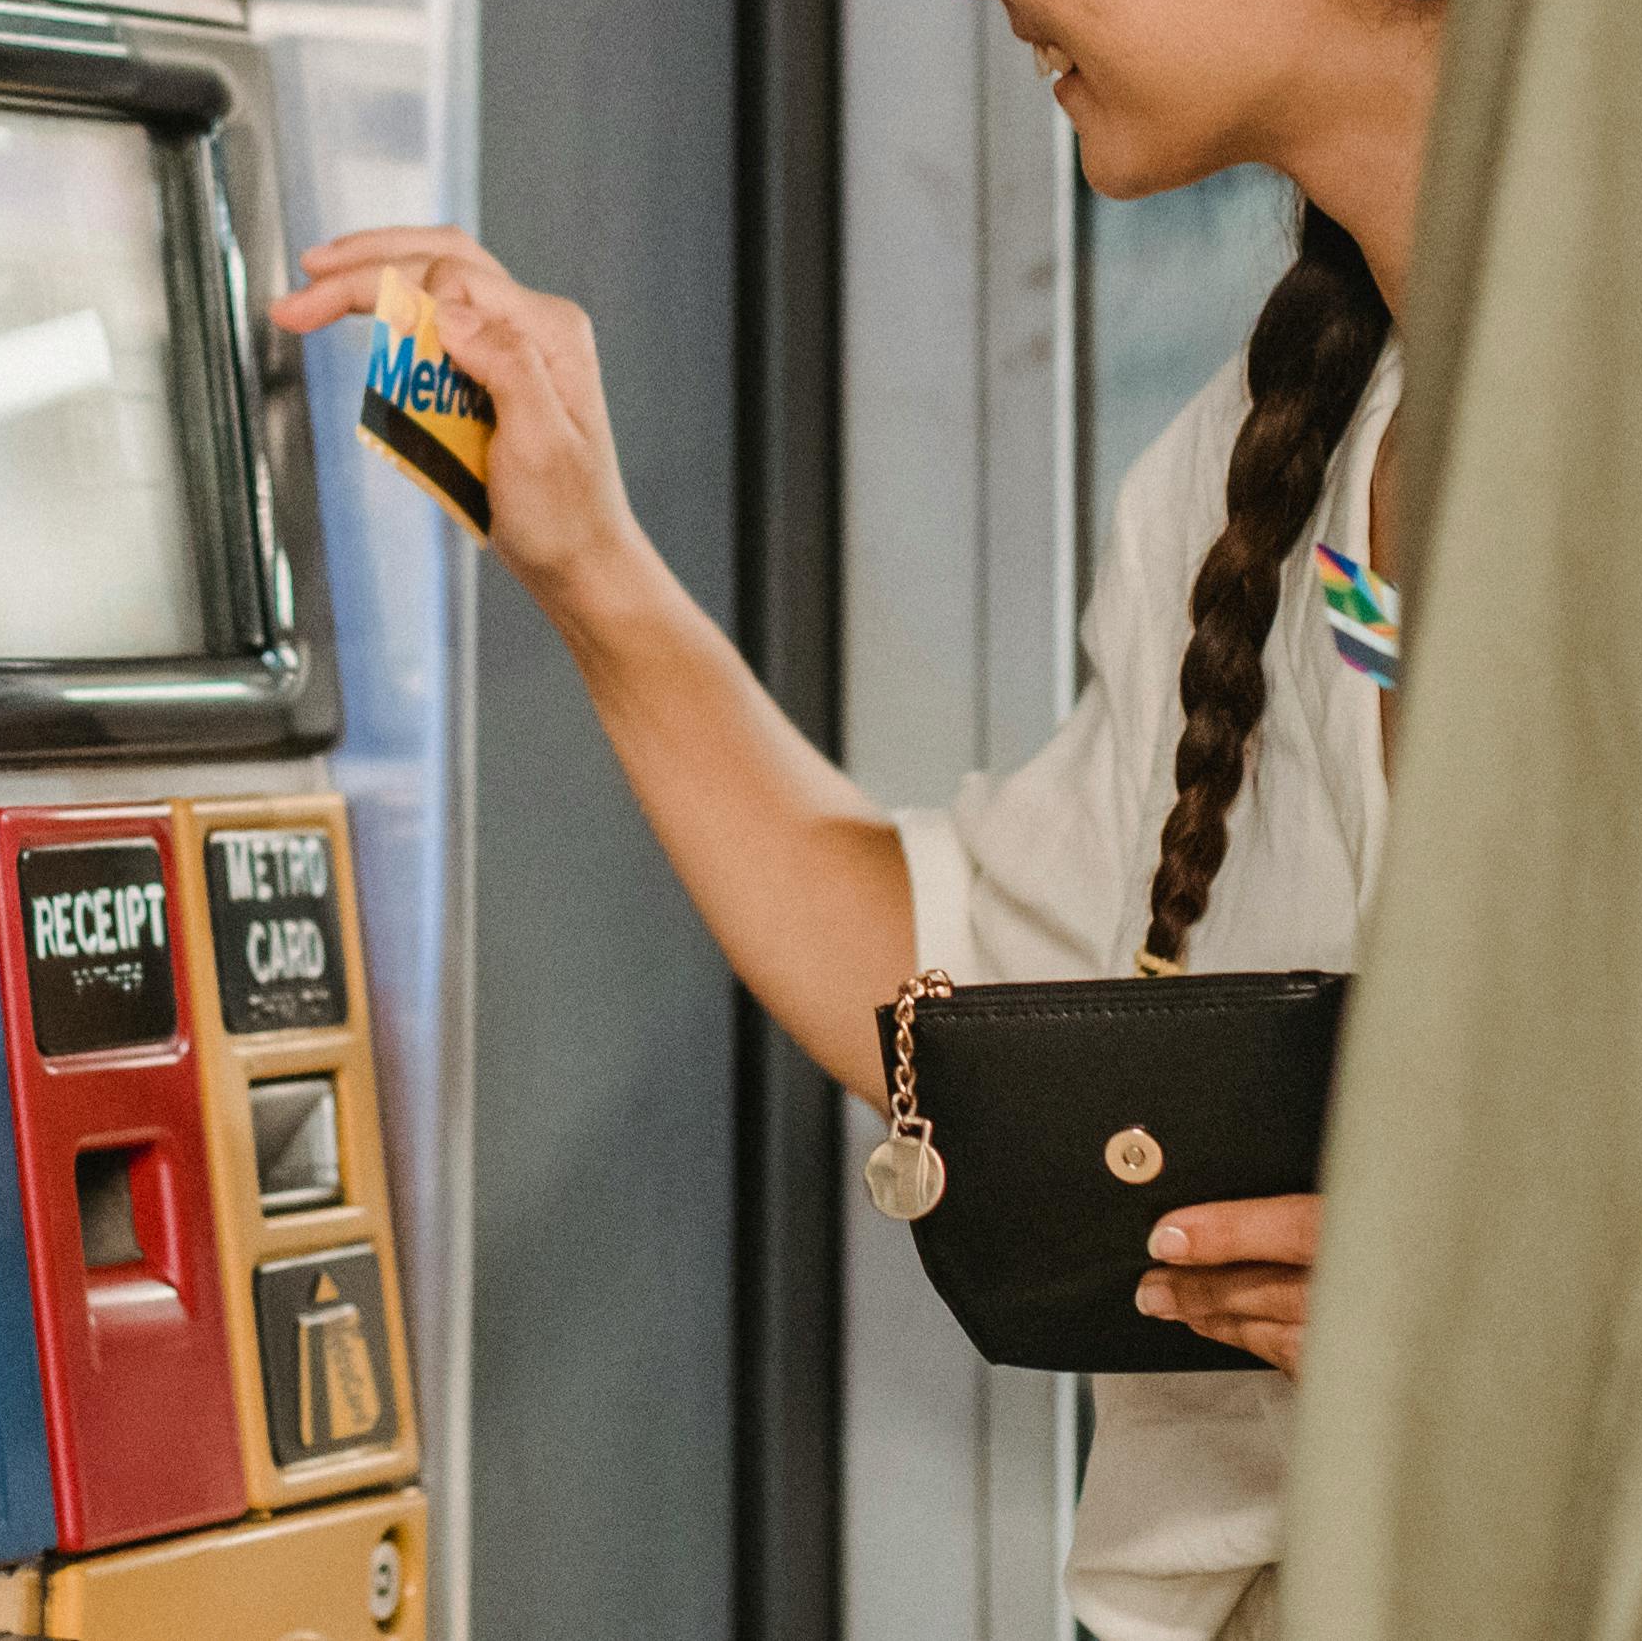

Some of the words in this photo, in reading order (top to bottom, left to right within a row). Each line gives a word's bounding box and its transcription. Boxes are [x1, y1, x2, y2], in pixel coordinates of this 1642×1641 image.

[225, 837, 328, 901] METRO
[32, 882, 165, 960] RECEIPT
[246, 919, 326, 984] CARD
